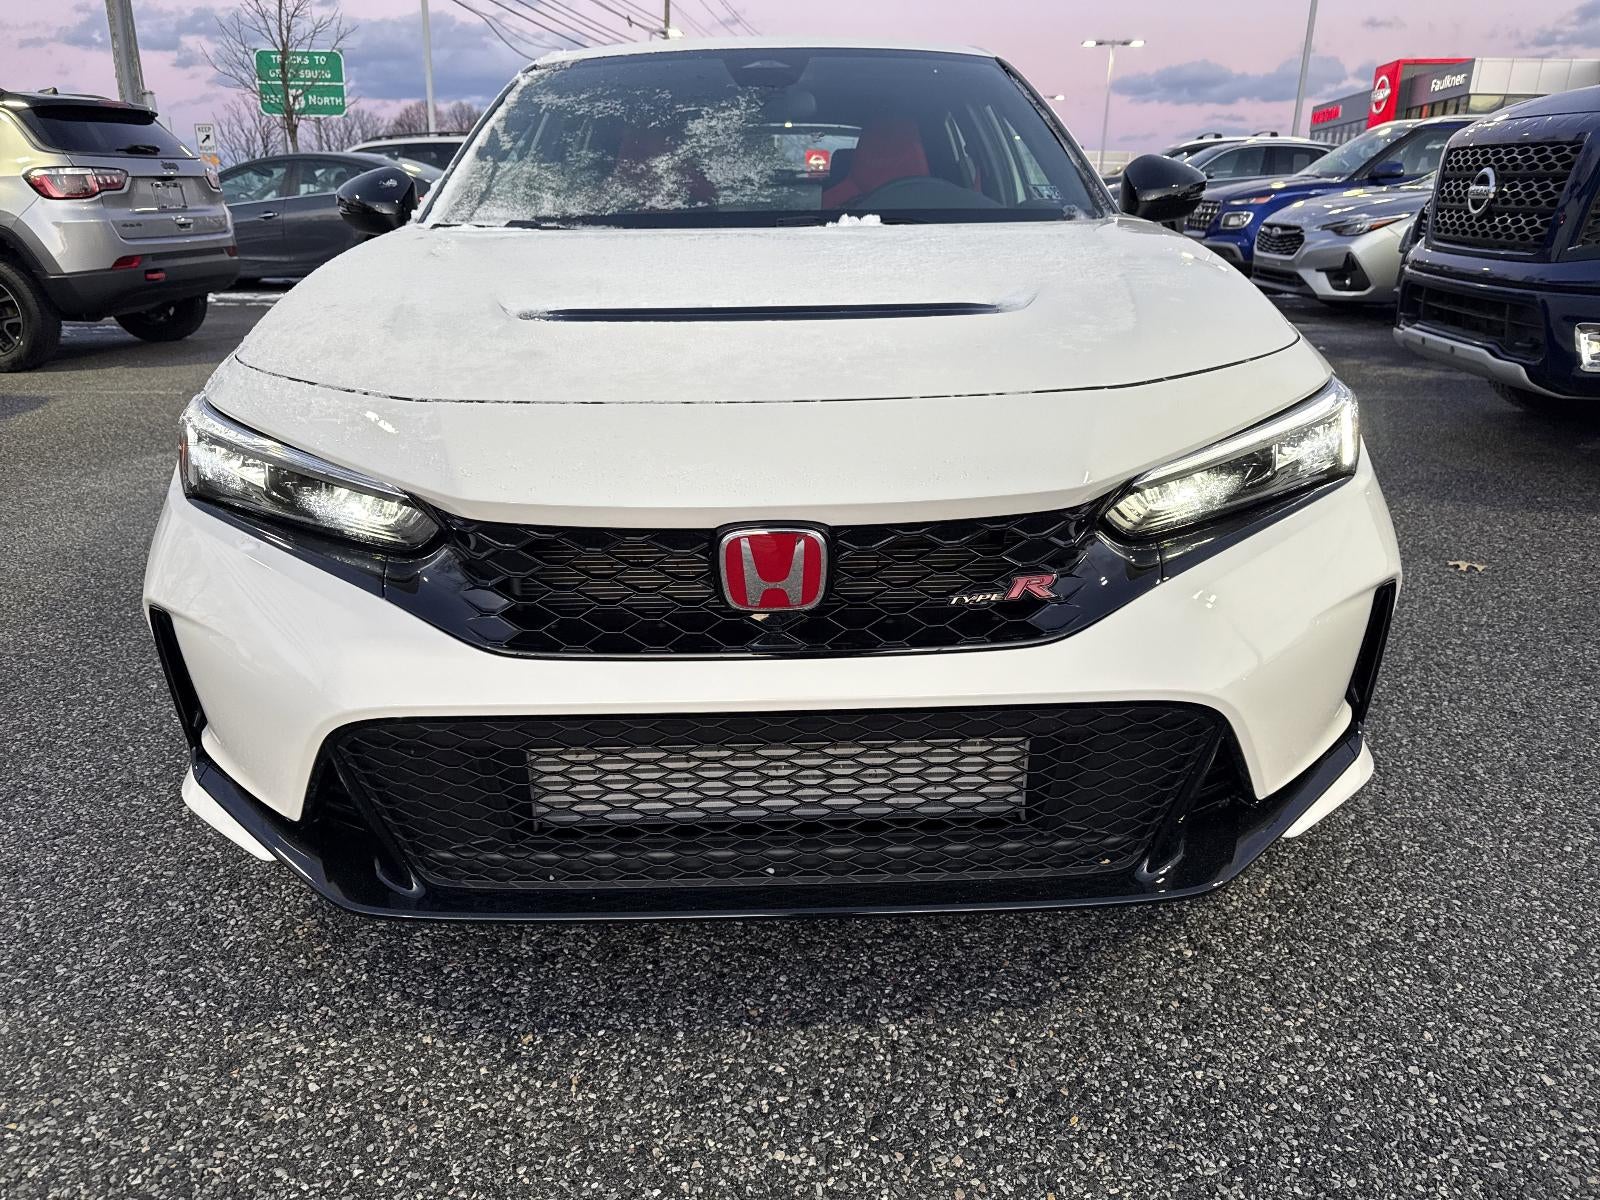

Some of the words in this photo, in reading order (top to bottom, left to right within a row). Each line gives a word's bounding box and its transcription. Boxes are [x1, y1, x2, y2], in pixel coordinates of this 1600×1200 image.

[271, 55, 309, 65] TRCKS
[314, 55, 327, 65] TO
[1431, 74, 1467, 92] Faulkner
[308, 95, 343, 105] NORTH
[950, 594, 1004, 605] TYPE
[1004, 574, 1058, 601] R
